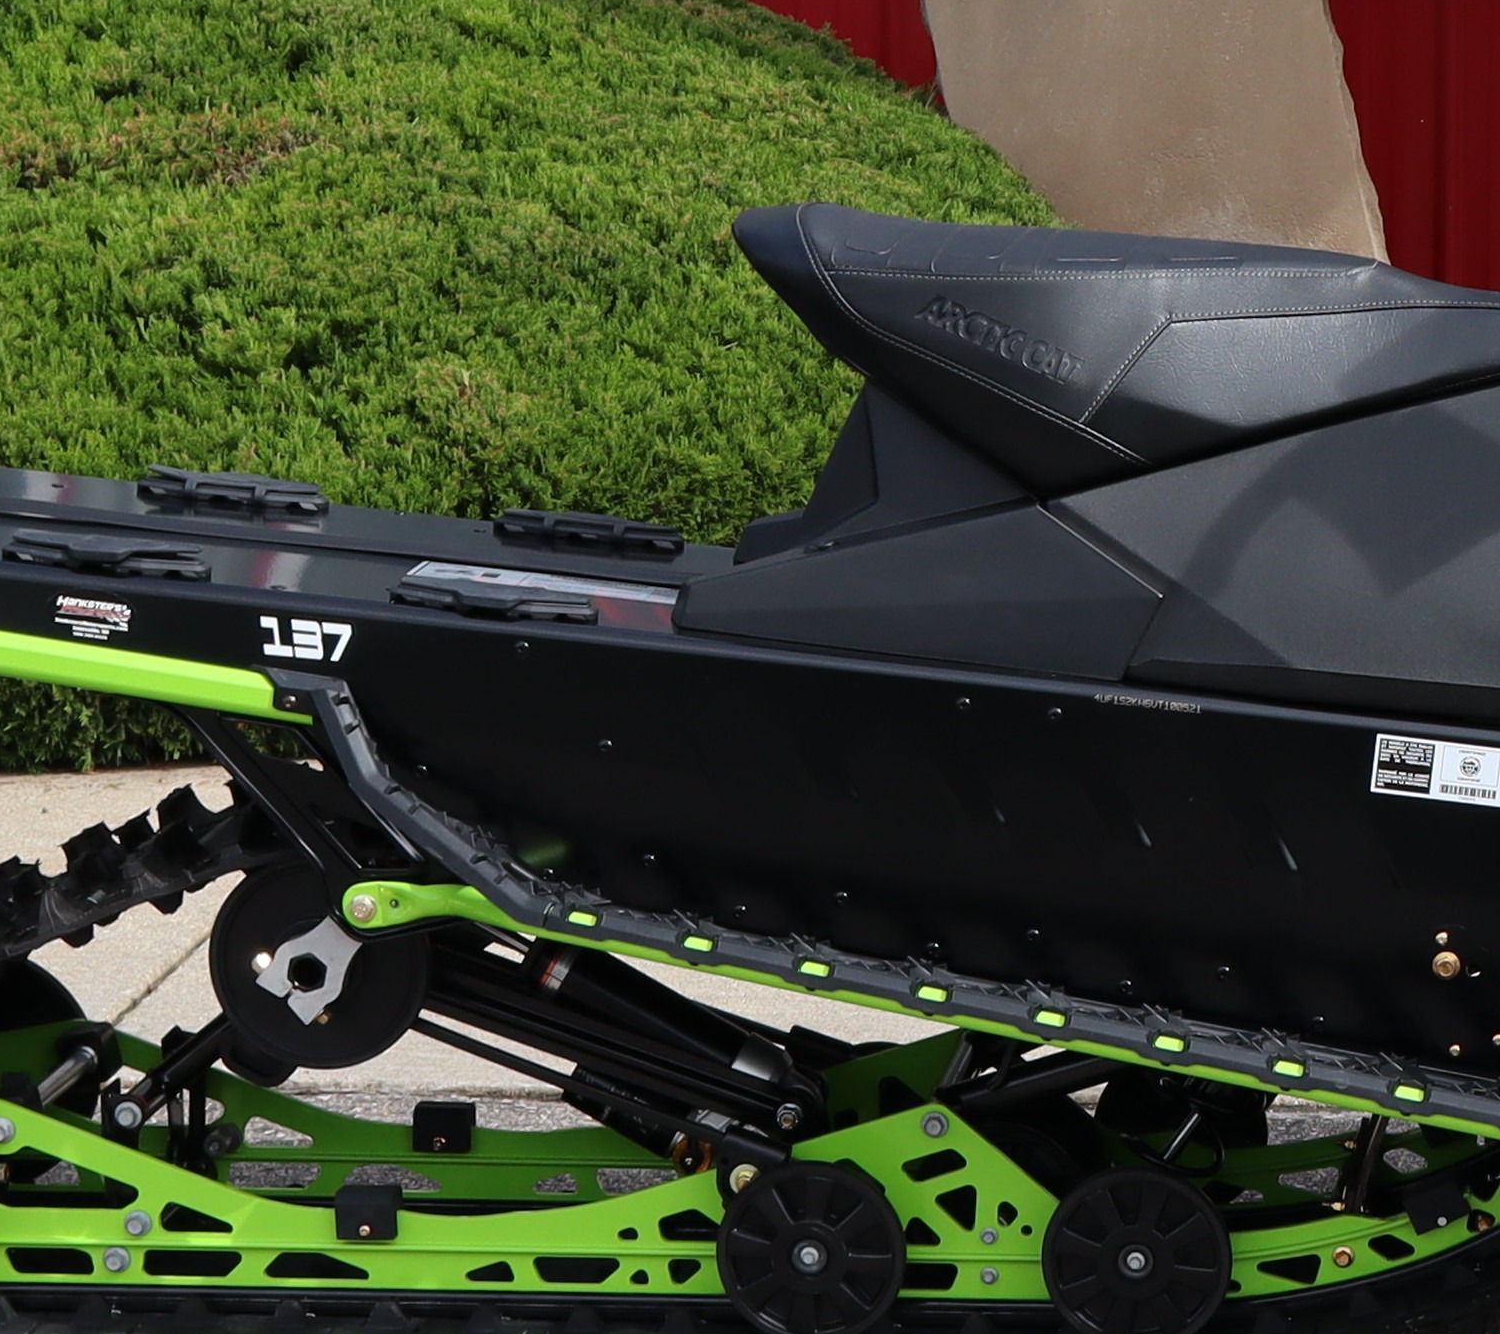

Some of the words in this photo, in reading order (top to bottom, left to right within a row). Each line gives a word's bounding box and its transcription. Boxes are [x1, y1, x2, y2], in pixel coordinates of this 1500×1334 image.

[914, 294, 1028, 360] ARCTIC
[1020, 339, 1084, 385] CAT
[259, 614, 353, 662] 137
